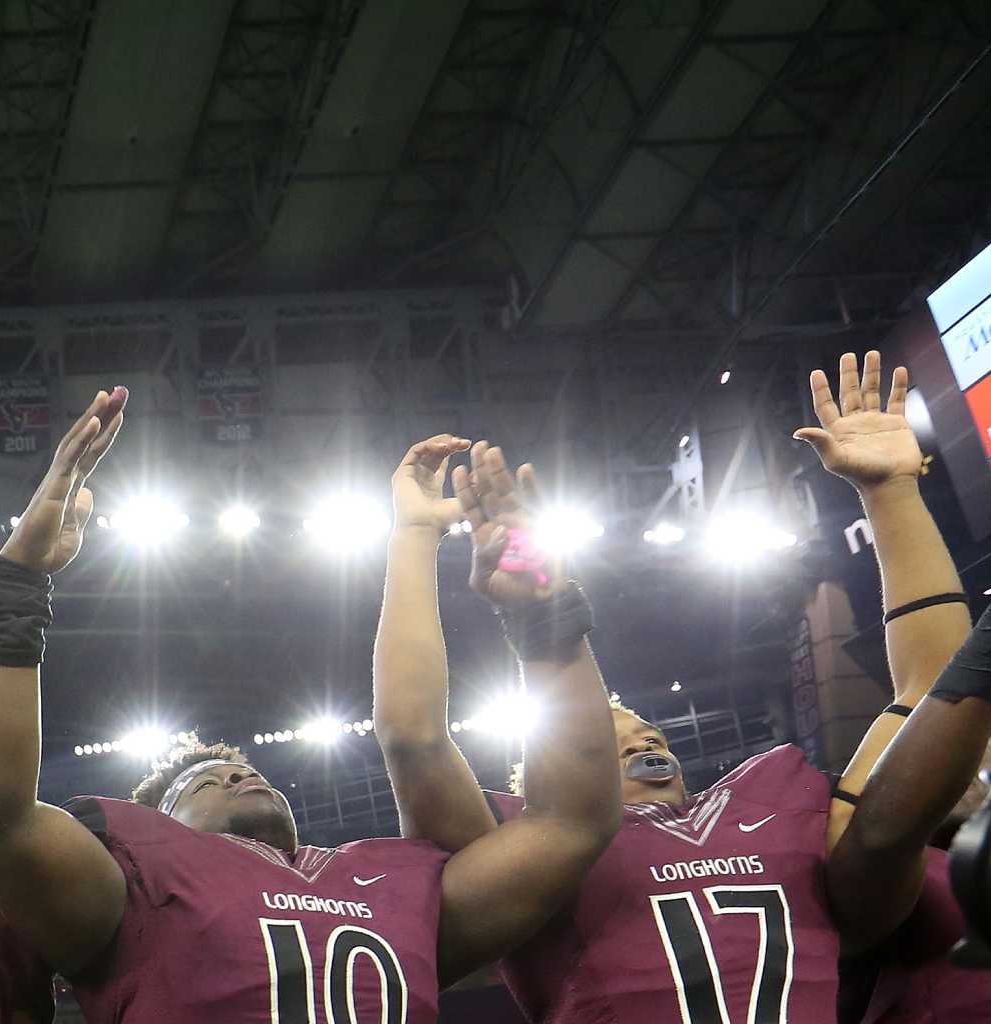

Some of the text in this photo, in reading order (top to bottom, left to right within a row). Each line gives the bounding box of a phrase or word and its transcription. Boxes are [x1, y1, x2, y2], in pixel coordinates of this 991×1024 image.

[4, 436, 36, 452] 2011
[649, 855, 764, 882] LONGHORNS
[261, 892, 373, 919] LONGHORNS
